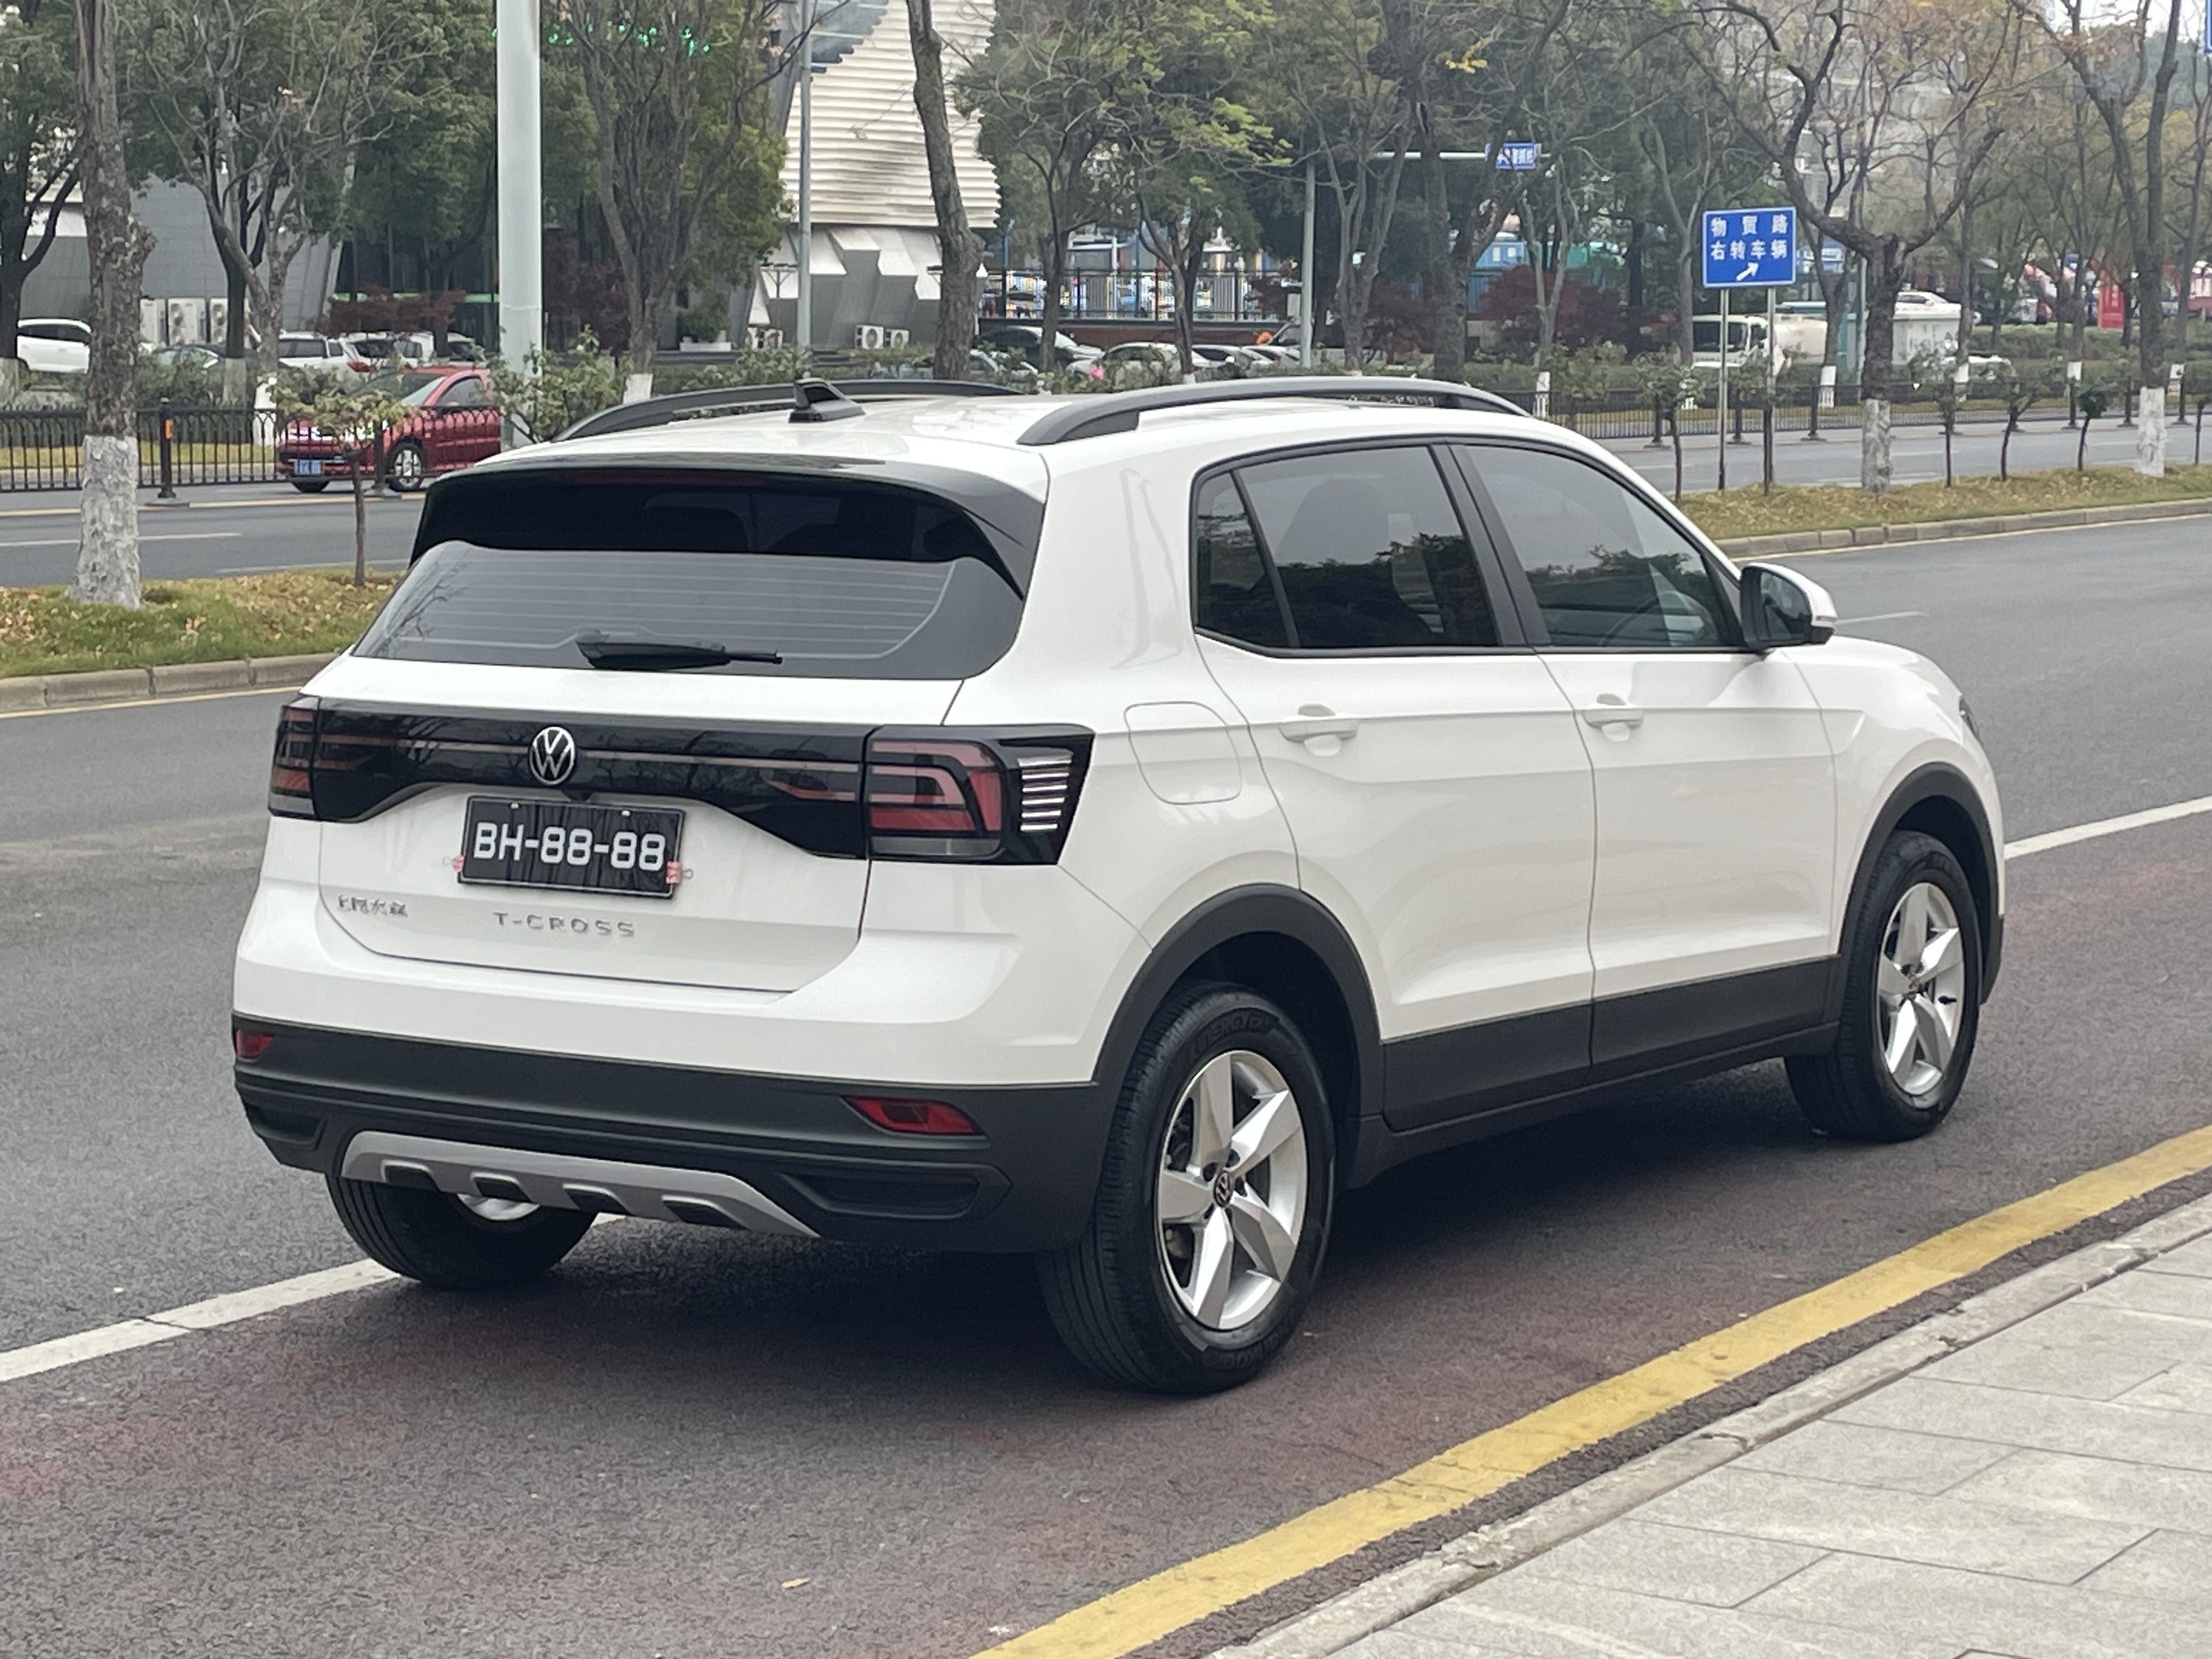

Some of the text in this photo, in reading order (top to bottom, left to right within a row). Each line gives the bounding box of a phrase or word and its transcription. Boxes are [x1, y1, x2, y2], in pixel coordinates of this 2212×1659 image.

[1710, 239, 1787, 261] 右转车辆
[529, 726, 575, 786] VW
[473, 822, 666, 871] BH-88-88
[493, 911, 634, 937] T-CROSS
